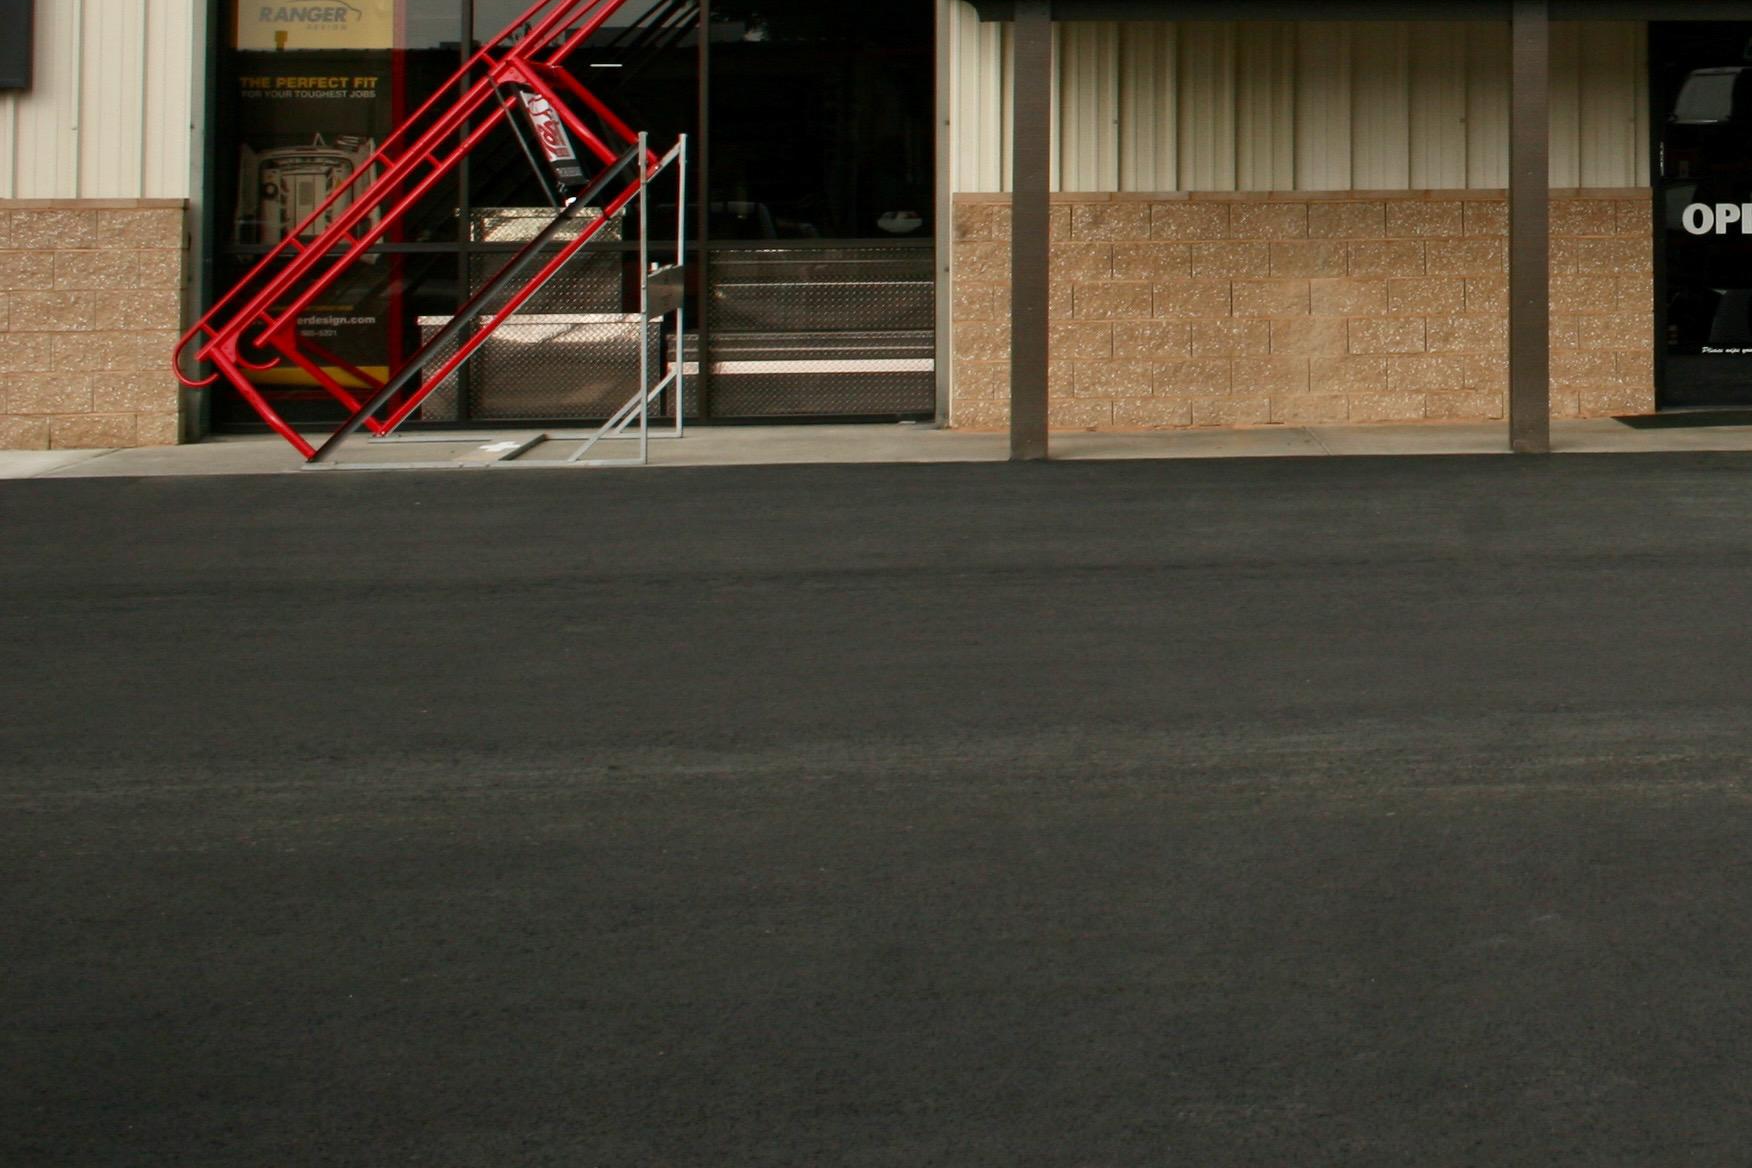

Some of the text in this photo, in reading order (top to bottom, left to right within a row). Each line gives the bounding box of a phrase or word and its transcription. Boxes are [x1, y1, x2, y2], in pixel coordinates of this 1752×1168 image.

[257, 6, 348, 23] RANGER
[239, 76, 379, 89] THE PERFECT FIT
[265, 90, 293, 99] YOUR
[295, 90, 348, 99] TOUGHEST
[349, 90, 377, 99] JOBS
